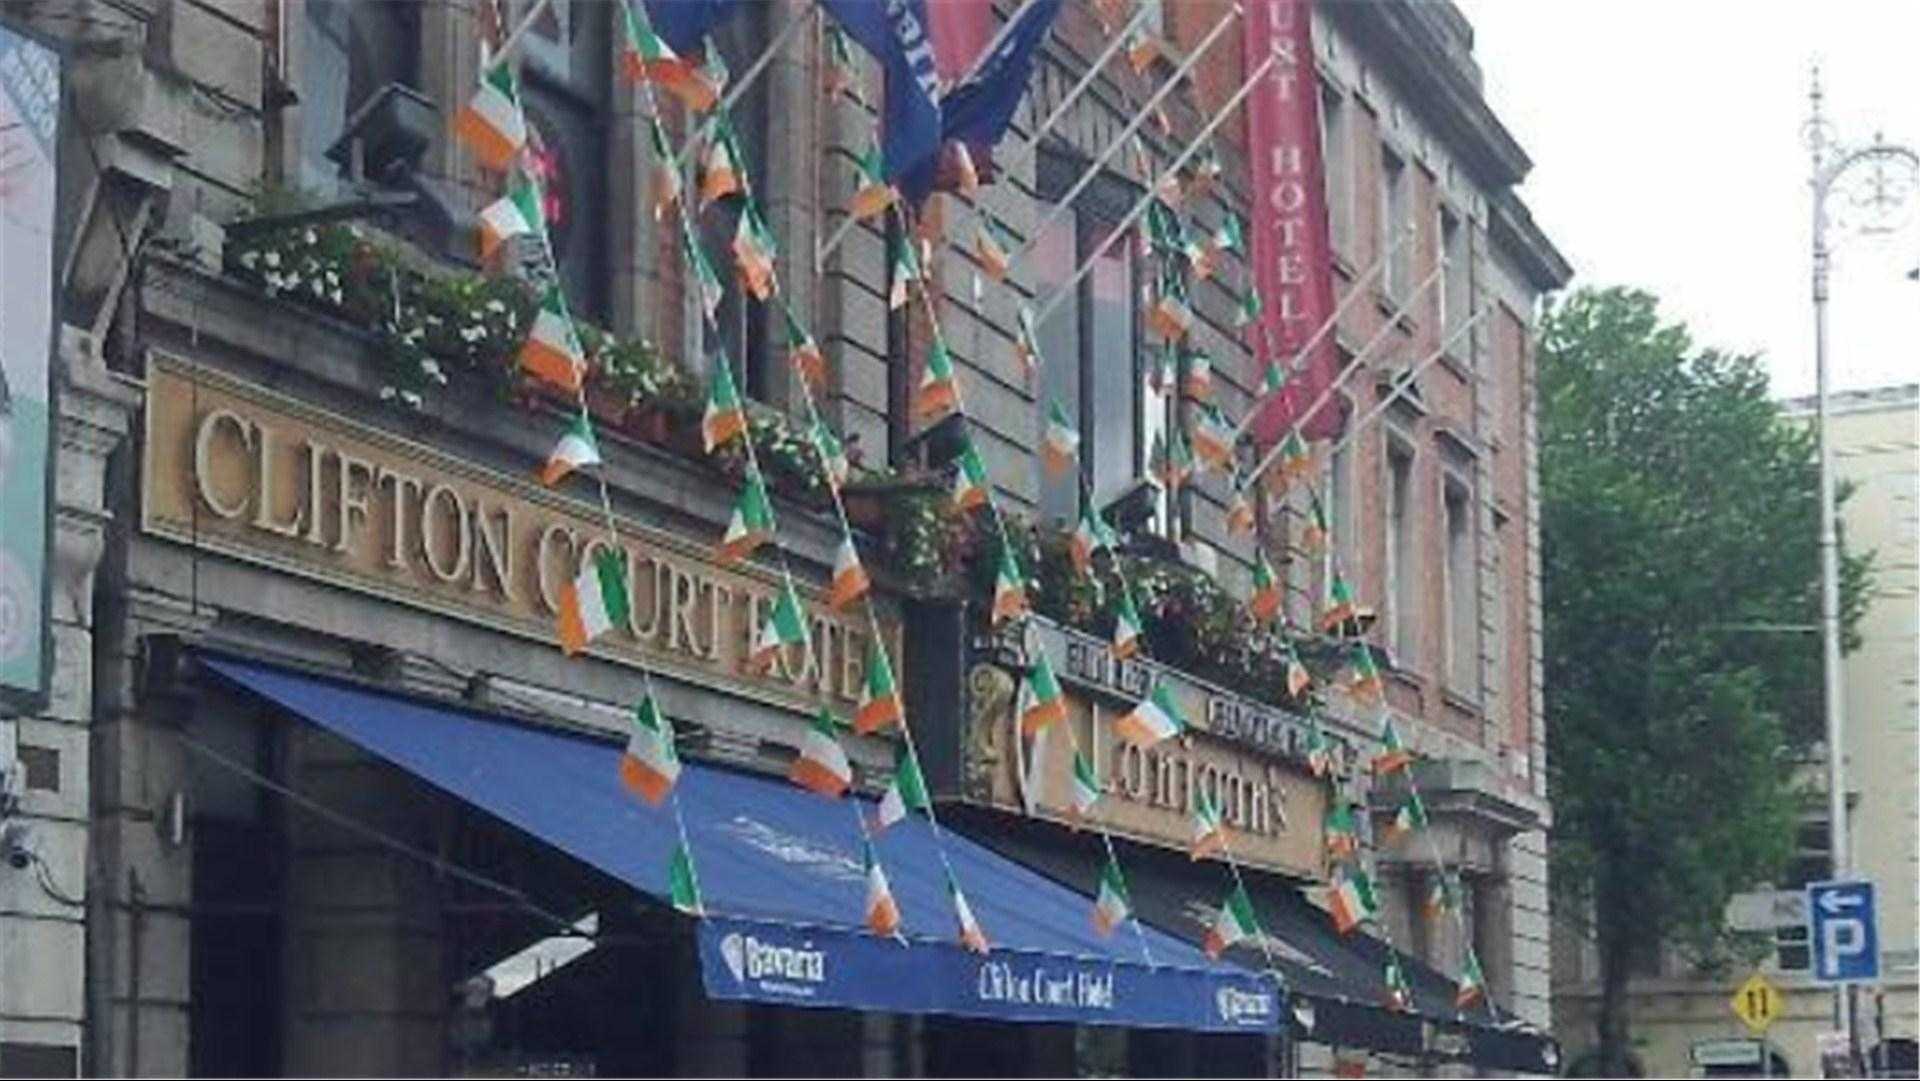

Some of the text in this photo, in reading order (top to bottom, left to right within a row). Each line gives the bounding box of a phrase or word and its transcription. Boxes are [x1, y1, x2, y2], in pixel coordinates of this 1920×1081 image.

[1271, 146, 1305, 321] HOTEL
[196, 409, 516, 600] CLIFTON
[748, 591, 884, 698] HOTE
[1823, 918, 1866, 976] P
